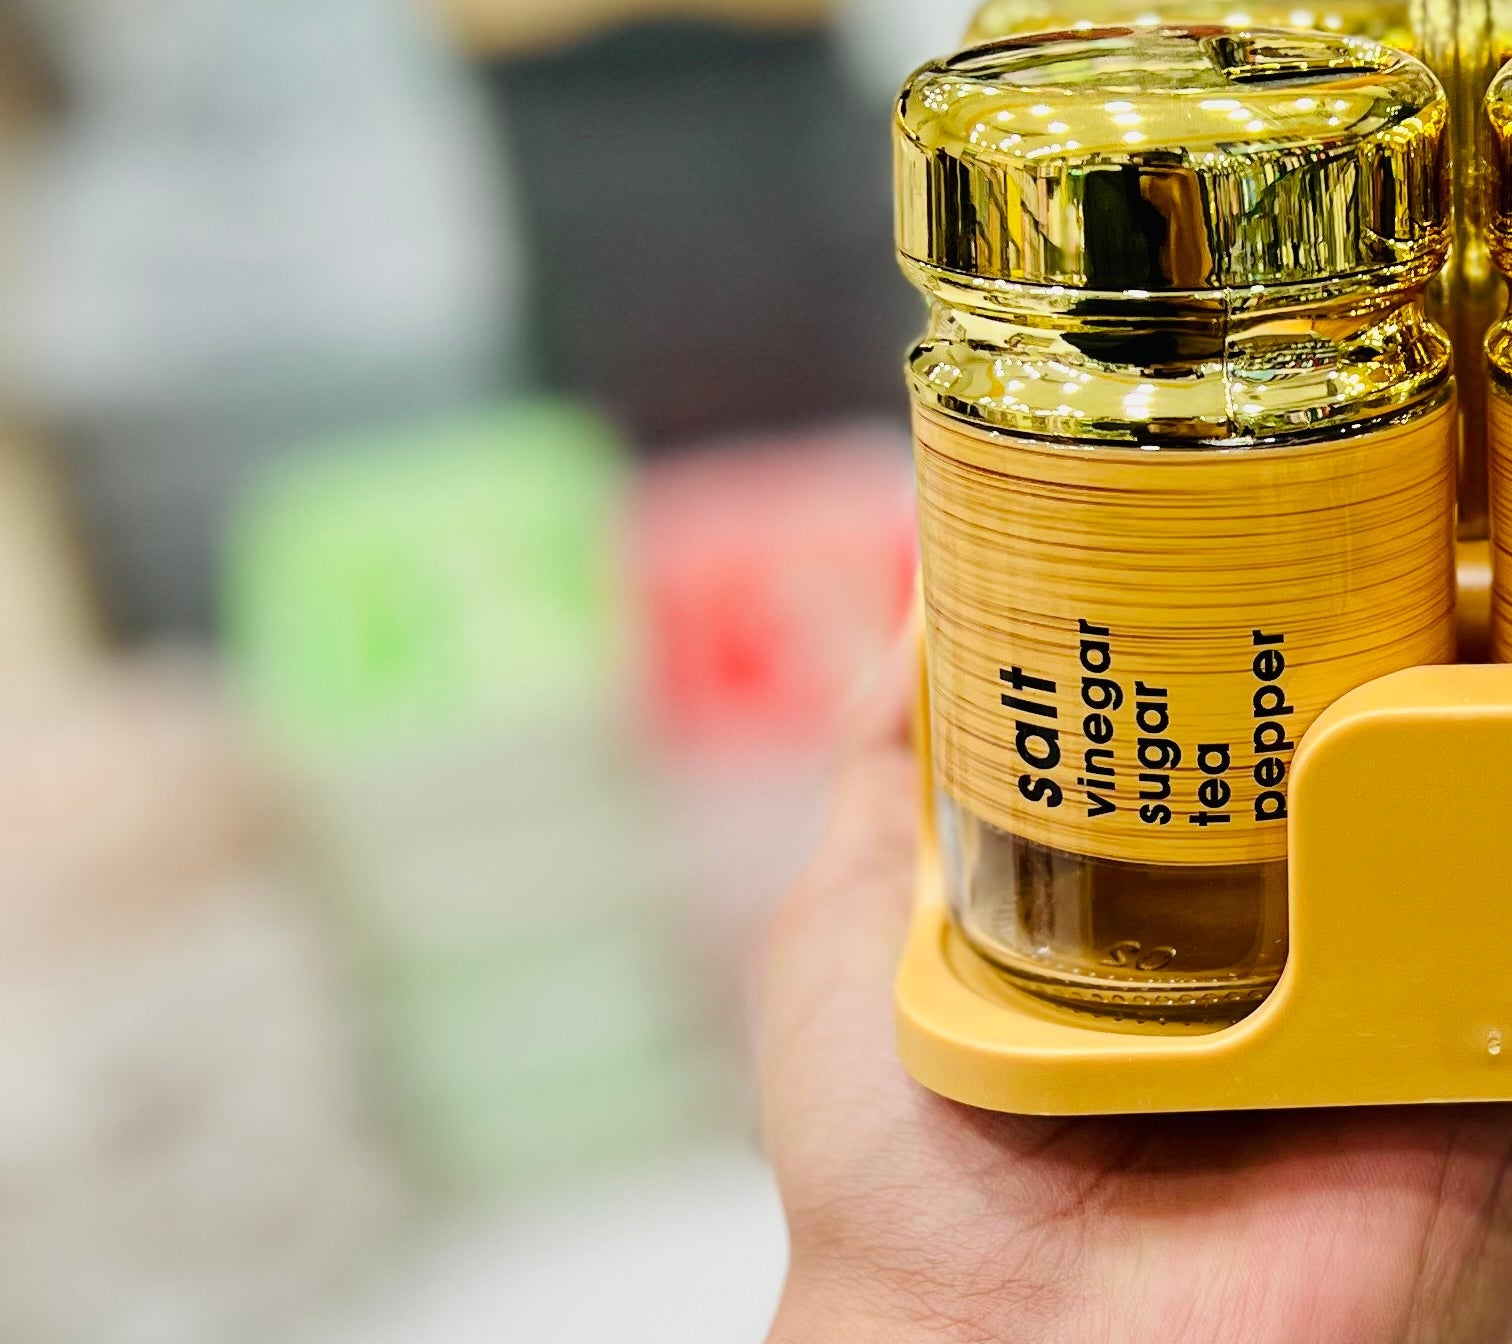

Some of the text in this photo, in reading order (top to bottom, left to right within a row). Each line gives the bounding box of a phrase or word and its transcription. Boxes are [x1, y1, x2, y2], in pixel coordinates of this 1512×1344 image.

[1000, 666, 1063, 808] salt
[1077, 619, 1123, 817] vinegar
[1134, 680, 1182, 825] sugar
[1189, 743, 1230, 826] tea
[1253, 630, 1294, 822] pepper
